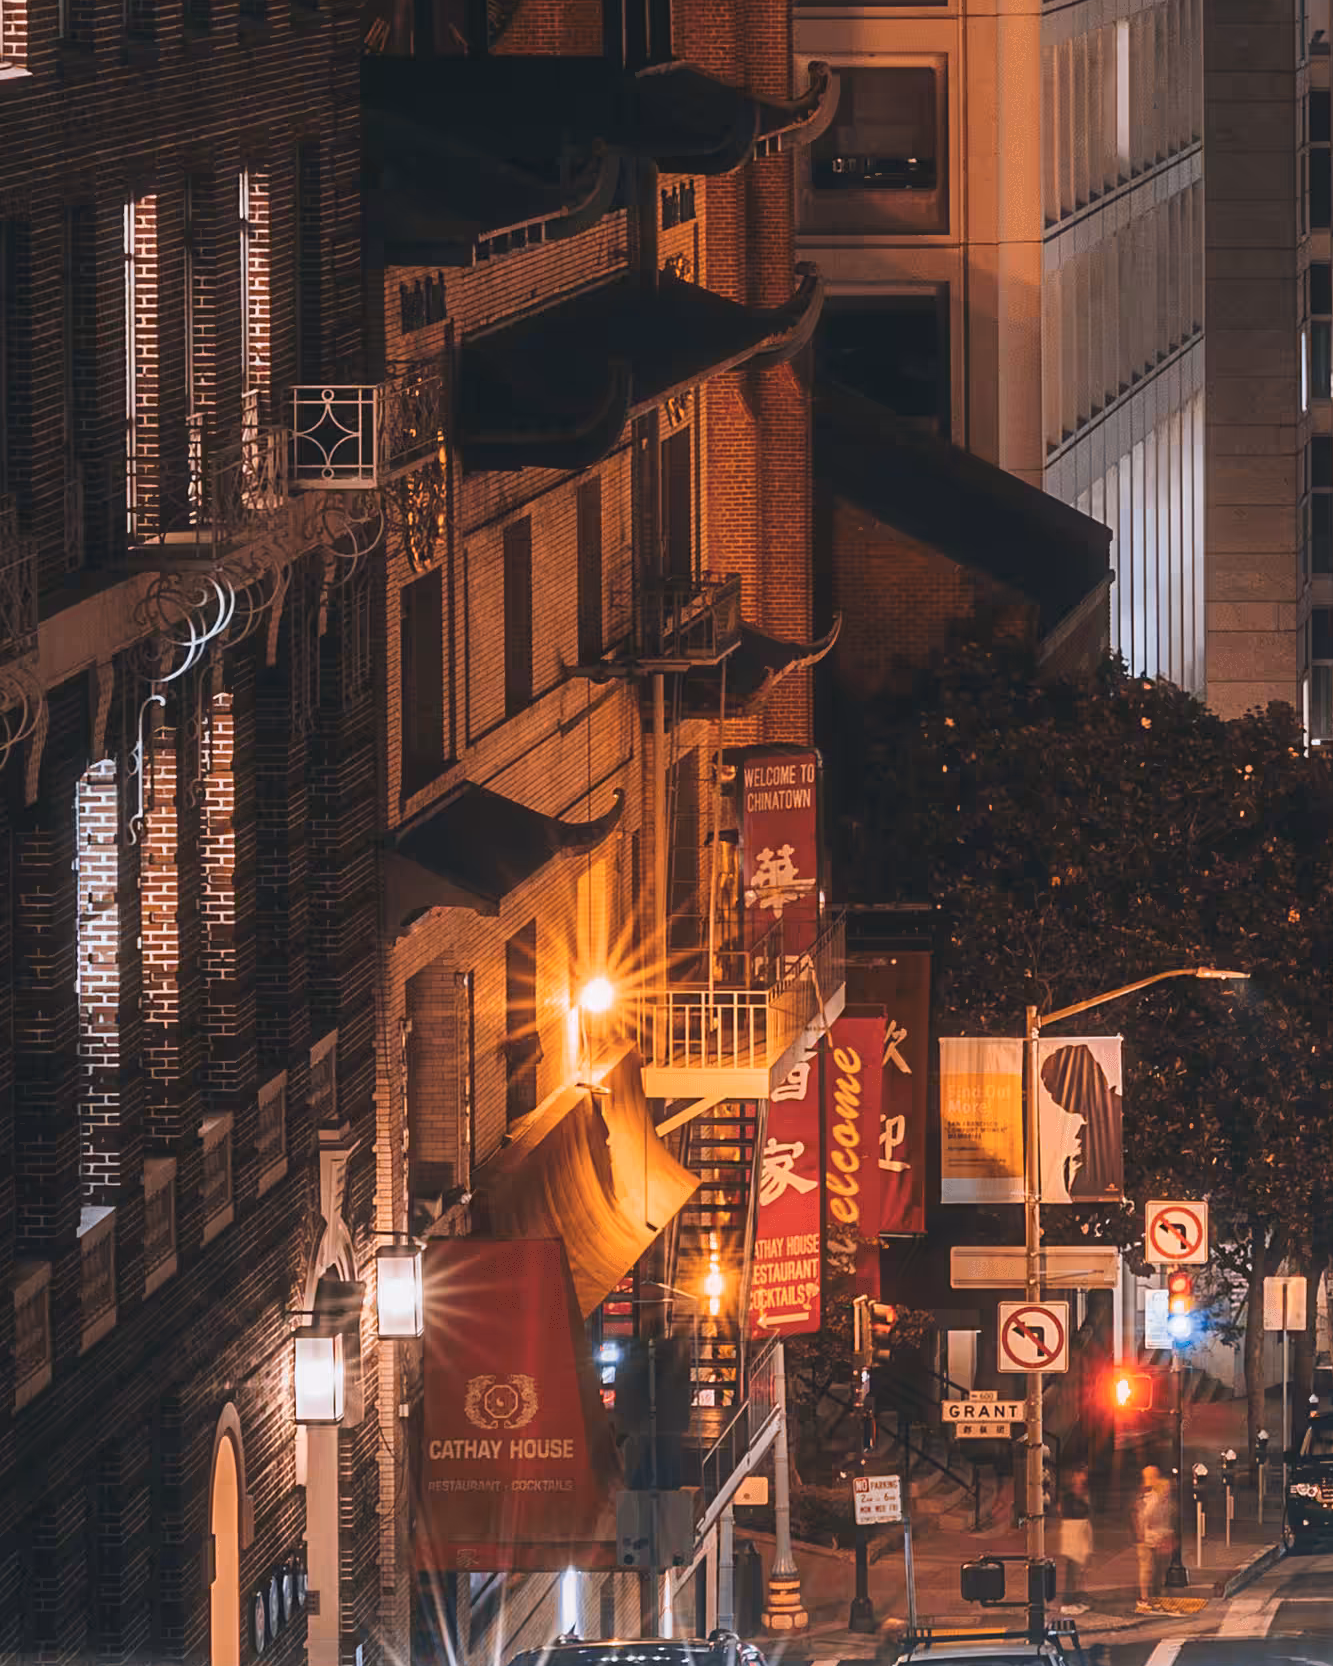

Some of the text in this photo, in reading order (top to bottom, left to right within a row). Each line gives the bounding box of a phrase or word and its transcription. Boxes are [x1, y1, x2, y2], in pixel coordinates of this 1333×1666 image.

[744, 763, 815, 787] WELCOME TO
[747, 788, 811, 812] CHINATOWN
[754, 1233, 820, 1260] ATHAY HOUSE
[753, 1258, 819, 1286] ESTAURANT
[949, 1405, 1017, 1418] GRANT
[429, 1439, 574, 1460] CATHAY HOUSE
[428, 1480, 574, 1492] RESTAURANT COCKTAILS
